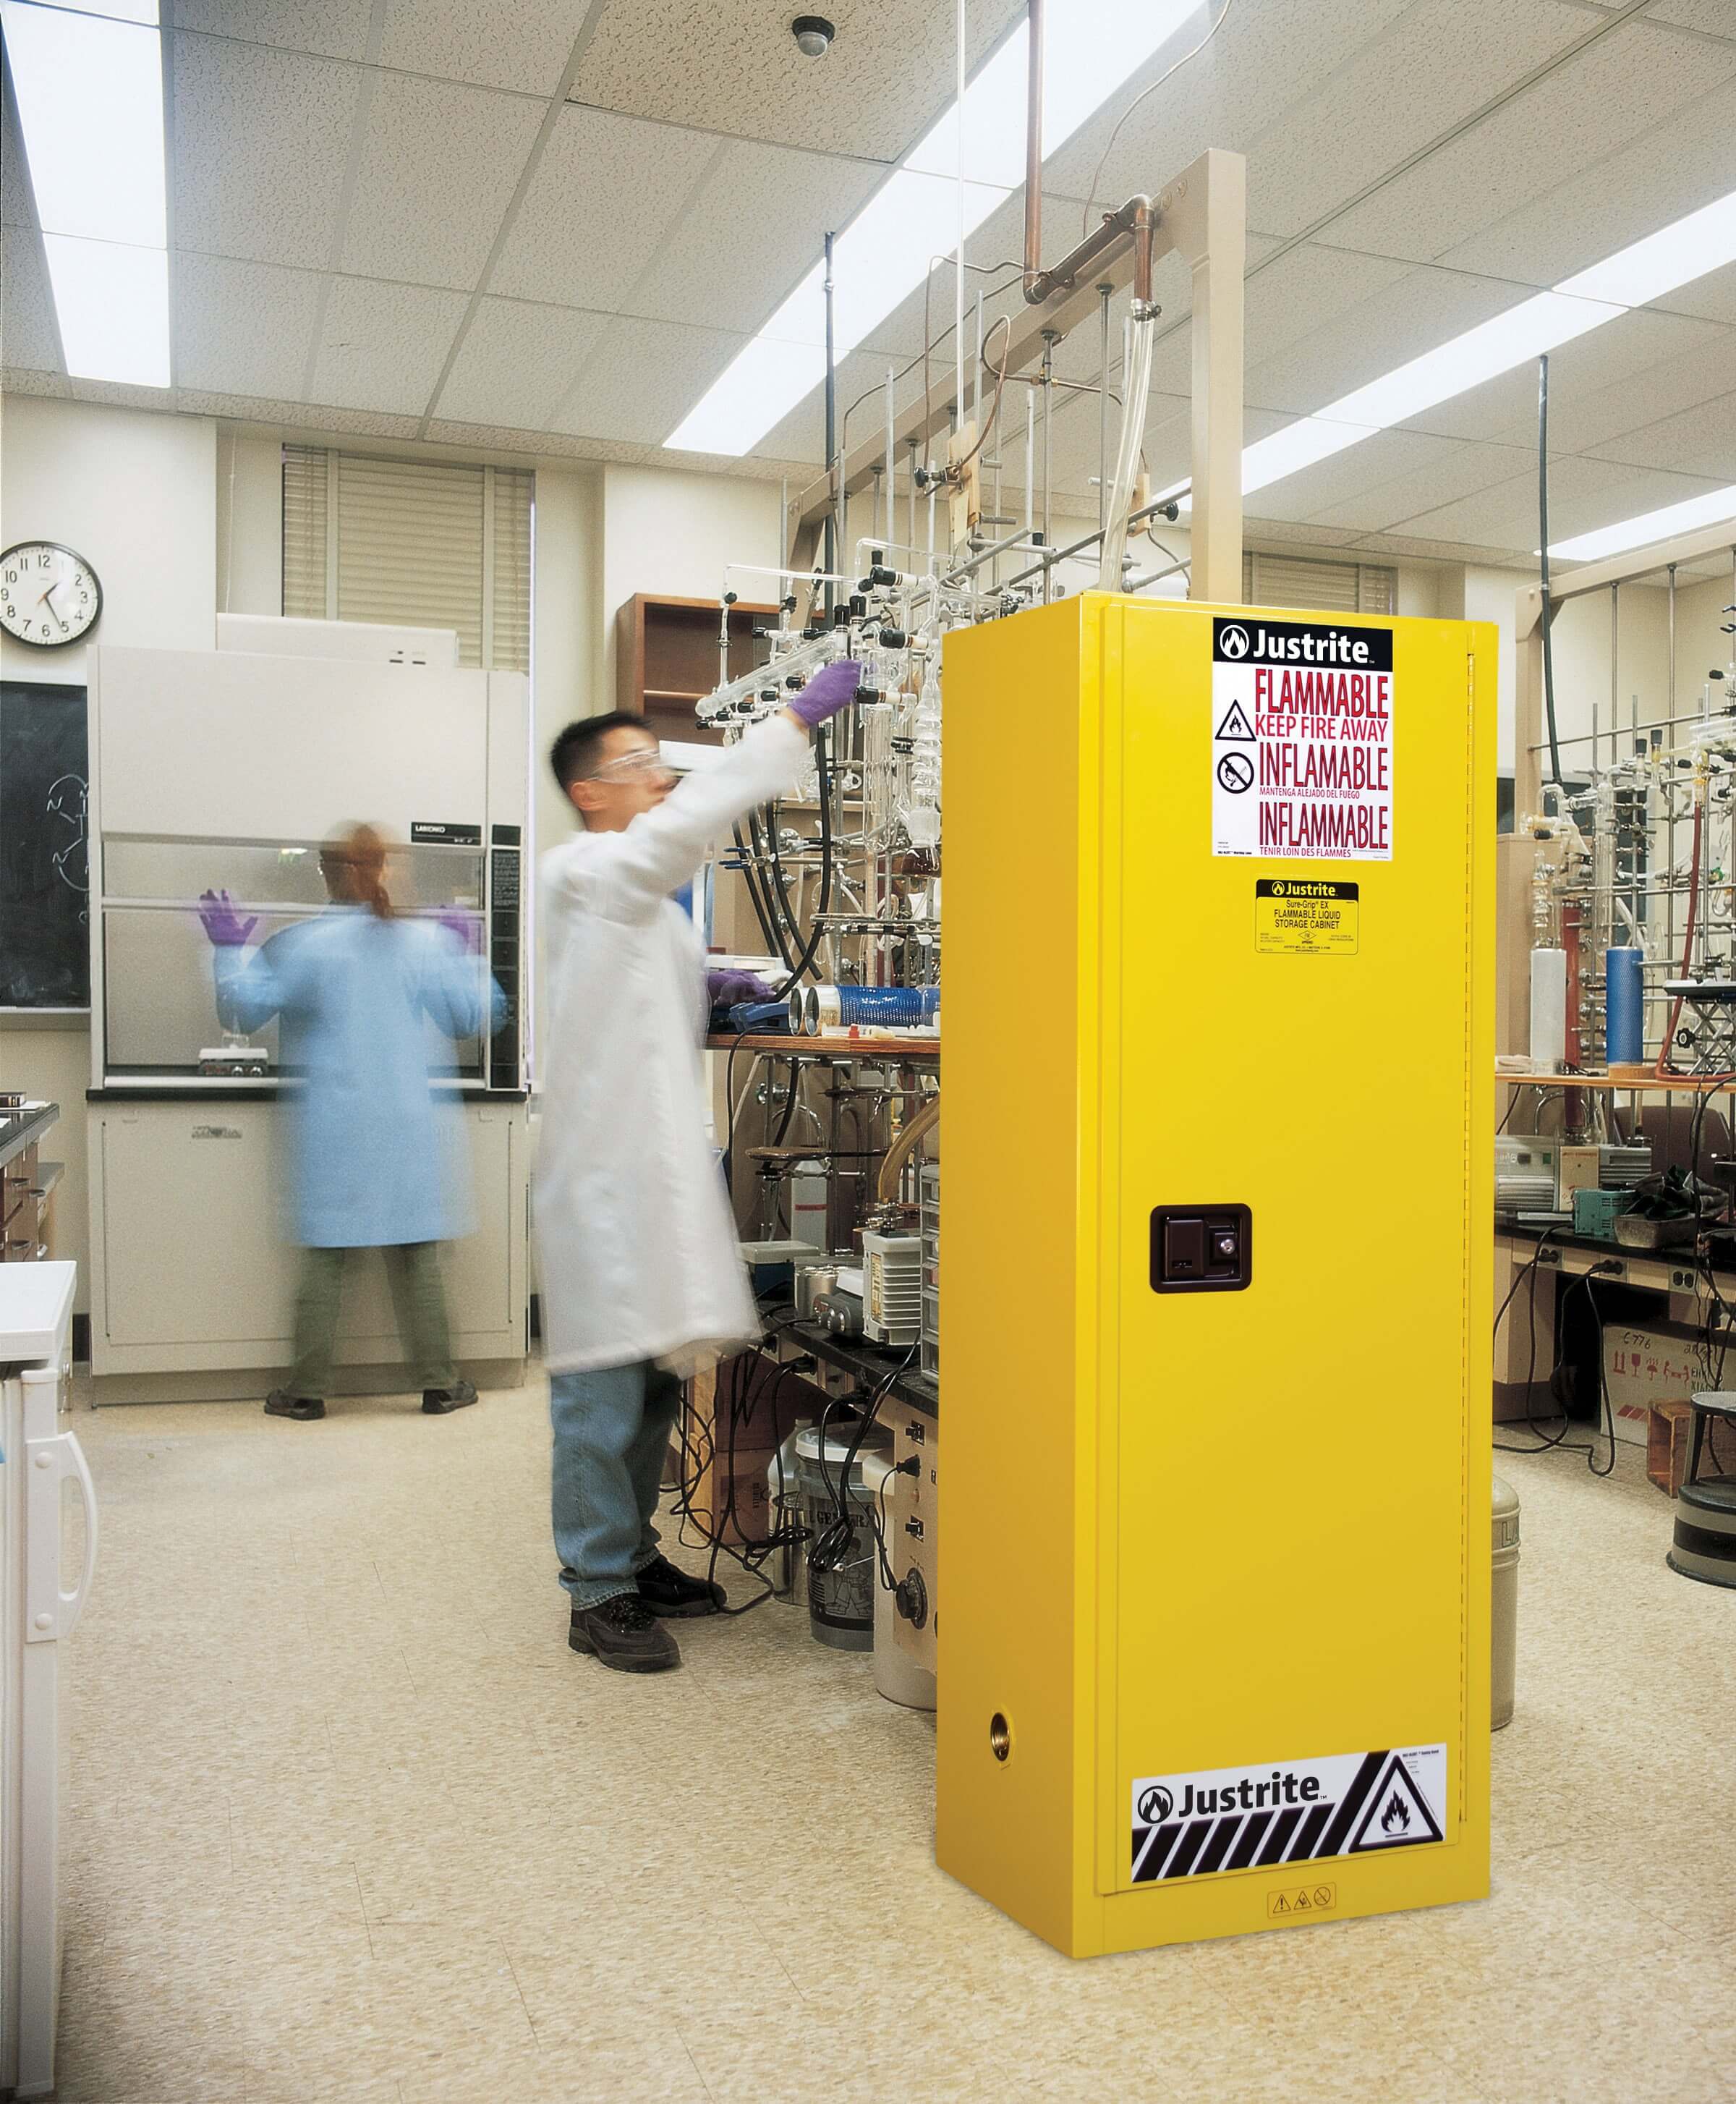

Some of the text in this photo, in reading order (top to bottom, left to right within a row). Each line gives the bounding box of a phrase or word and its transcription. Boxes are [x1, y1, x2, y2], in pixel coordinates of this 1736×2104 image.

[20, 558, 28, 571] 11
[38, 555, 51, 568] 12
[5, 570, 17, 583] 10
[75, 574, 82, 586] 2
[0, 588, 9, 601] 9
[80, 591, 88, 603] 3
[7, 605, 16, 618] 8
[75, 610, 83, 621] 4
[23, 619, 32, 632] 7
[42, 624, 50, 637] 6
[61, 621, 69, 633] 5
[1255, 669, 1388, 718] FLAMMABLE
[1255, 714, 1388, 742] KEEP FIRE AWAY
[1259, 742, 1388, 791] INFLAMABLE
[1259, 786, 1360, 799] MANTENGA ALEJADO DEL FUEGO
[1259, 801, 1388, 849] INFLAMMABLE
[1259, 847, 1281, 856] TENIR
[1282, 847, 1299, 856] LOIN
[1301, 848, 1315, 857] DES
[1316, 848, 1351, 857] FLAMMES
[1285, 882, 1336, 896] Justrite
[1274, 909, 1340, 920] FLAMMABLE LIQUID
[1275, 919, 1340, 929] STORAGE CABINET
